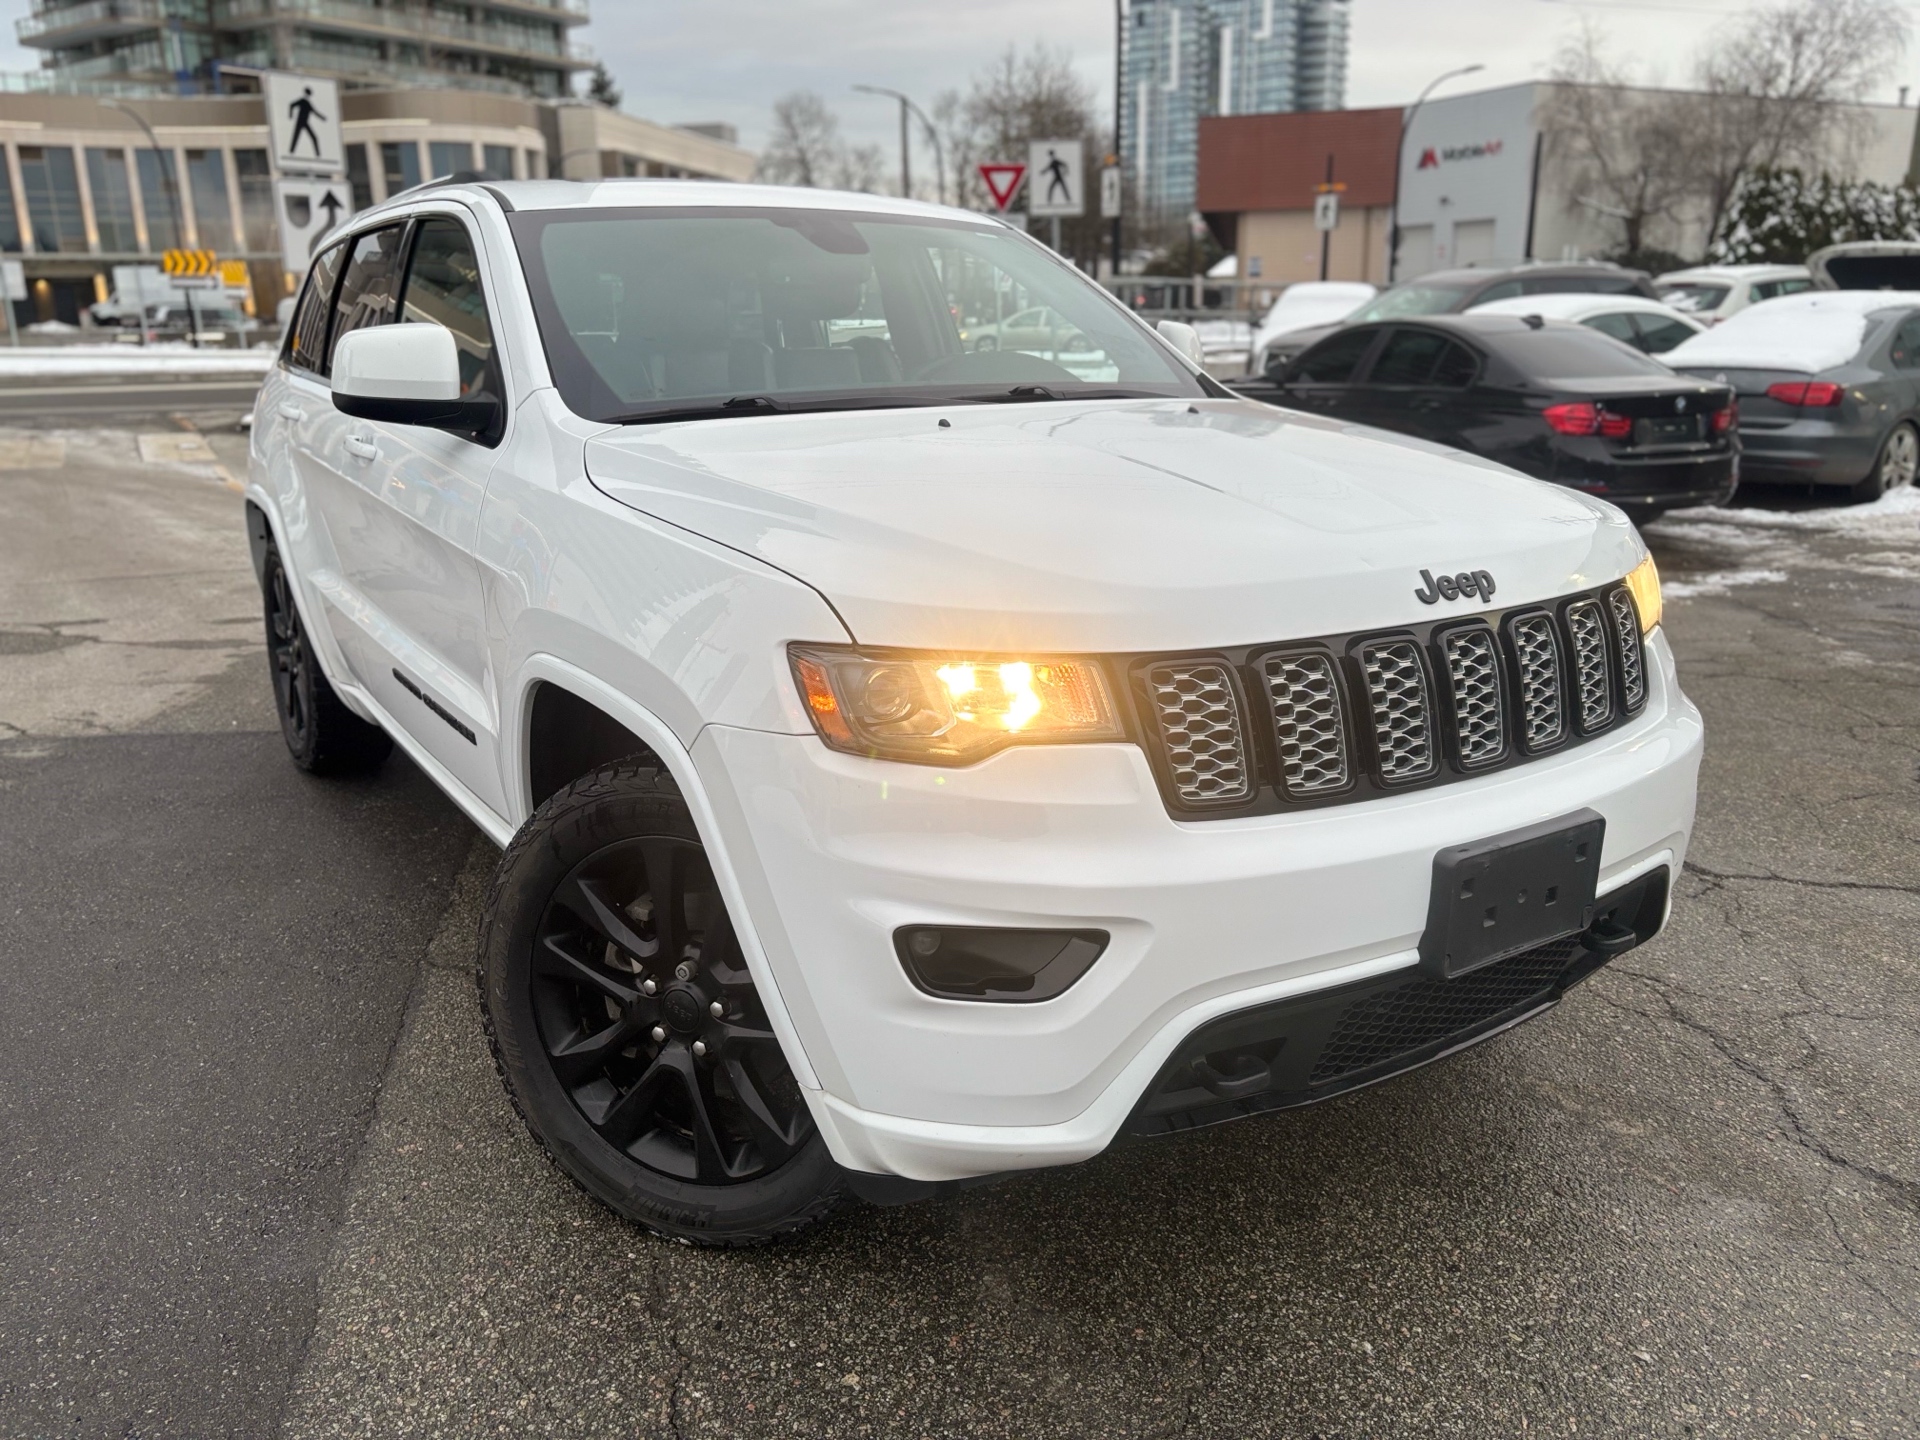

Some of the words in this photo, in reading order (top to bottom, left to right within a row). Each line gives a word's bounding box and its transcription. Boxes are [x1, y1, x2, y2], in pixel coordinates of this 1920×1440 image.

[1415, 568, 1495, 604] Jeep
[493, 892, 526, 1069] HERCULES
[666, 1000, 693, 1021] Jeep
